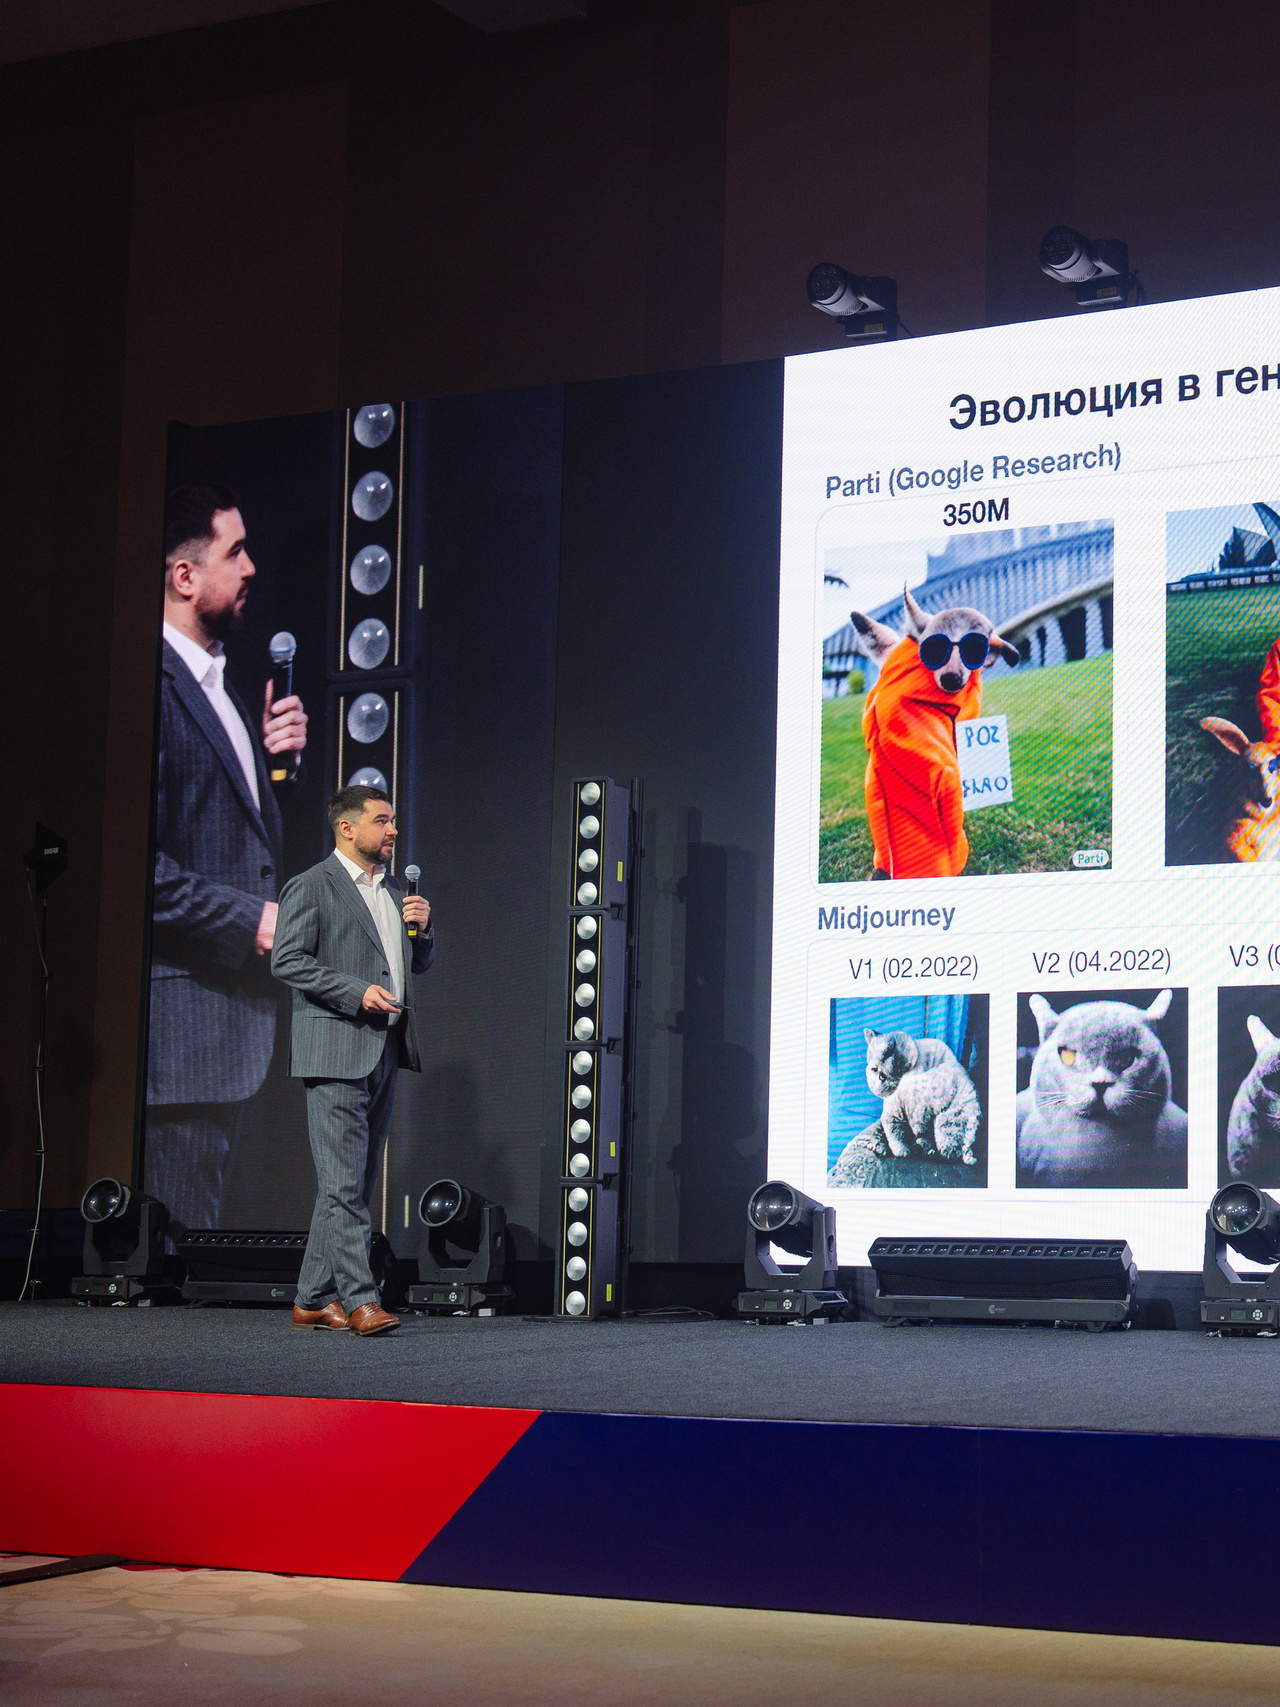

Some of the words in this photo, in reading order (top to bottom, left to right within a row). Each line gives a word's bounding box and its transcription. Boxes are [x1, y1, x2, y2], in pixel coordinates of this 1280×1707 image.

[949, 376, 1163, 430] Эволюция
[1178, 374, 1201, 402] в
[825, 470, 881, 499] Parti
[888, 461, 986, 497] (Google
[992, 443, 1122, 481] Research)
[943, 498, 1010, 529] 350M
[1078, 853, 1104, 864] Parti
[817, 905, 956, 933] Midjourney
[849, 959, 873, 979] V1
[882, 956, 979, 982] (02.2022)
[1033, 952, 1060, 974] V2
[1068, 948, 1171, 977] (04.2022)
[1229, 945, 1259, 968] V3
